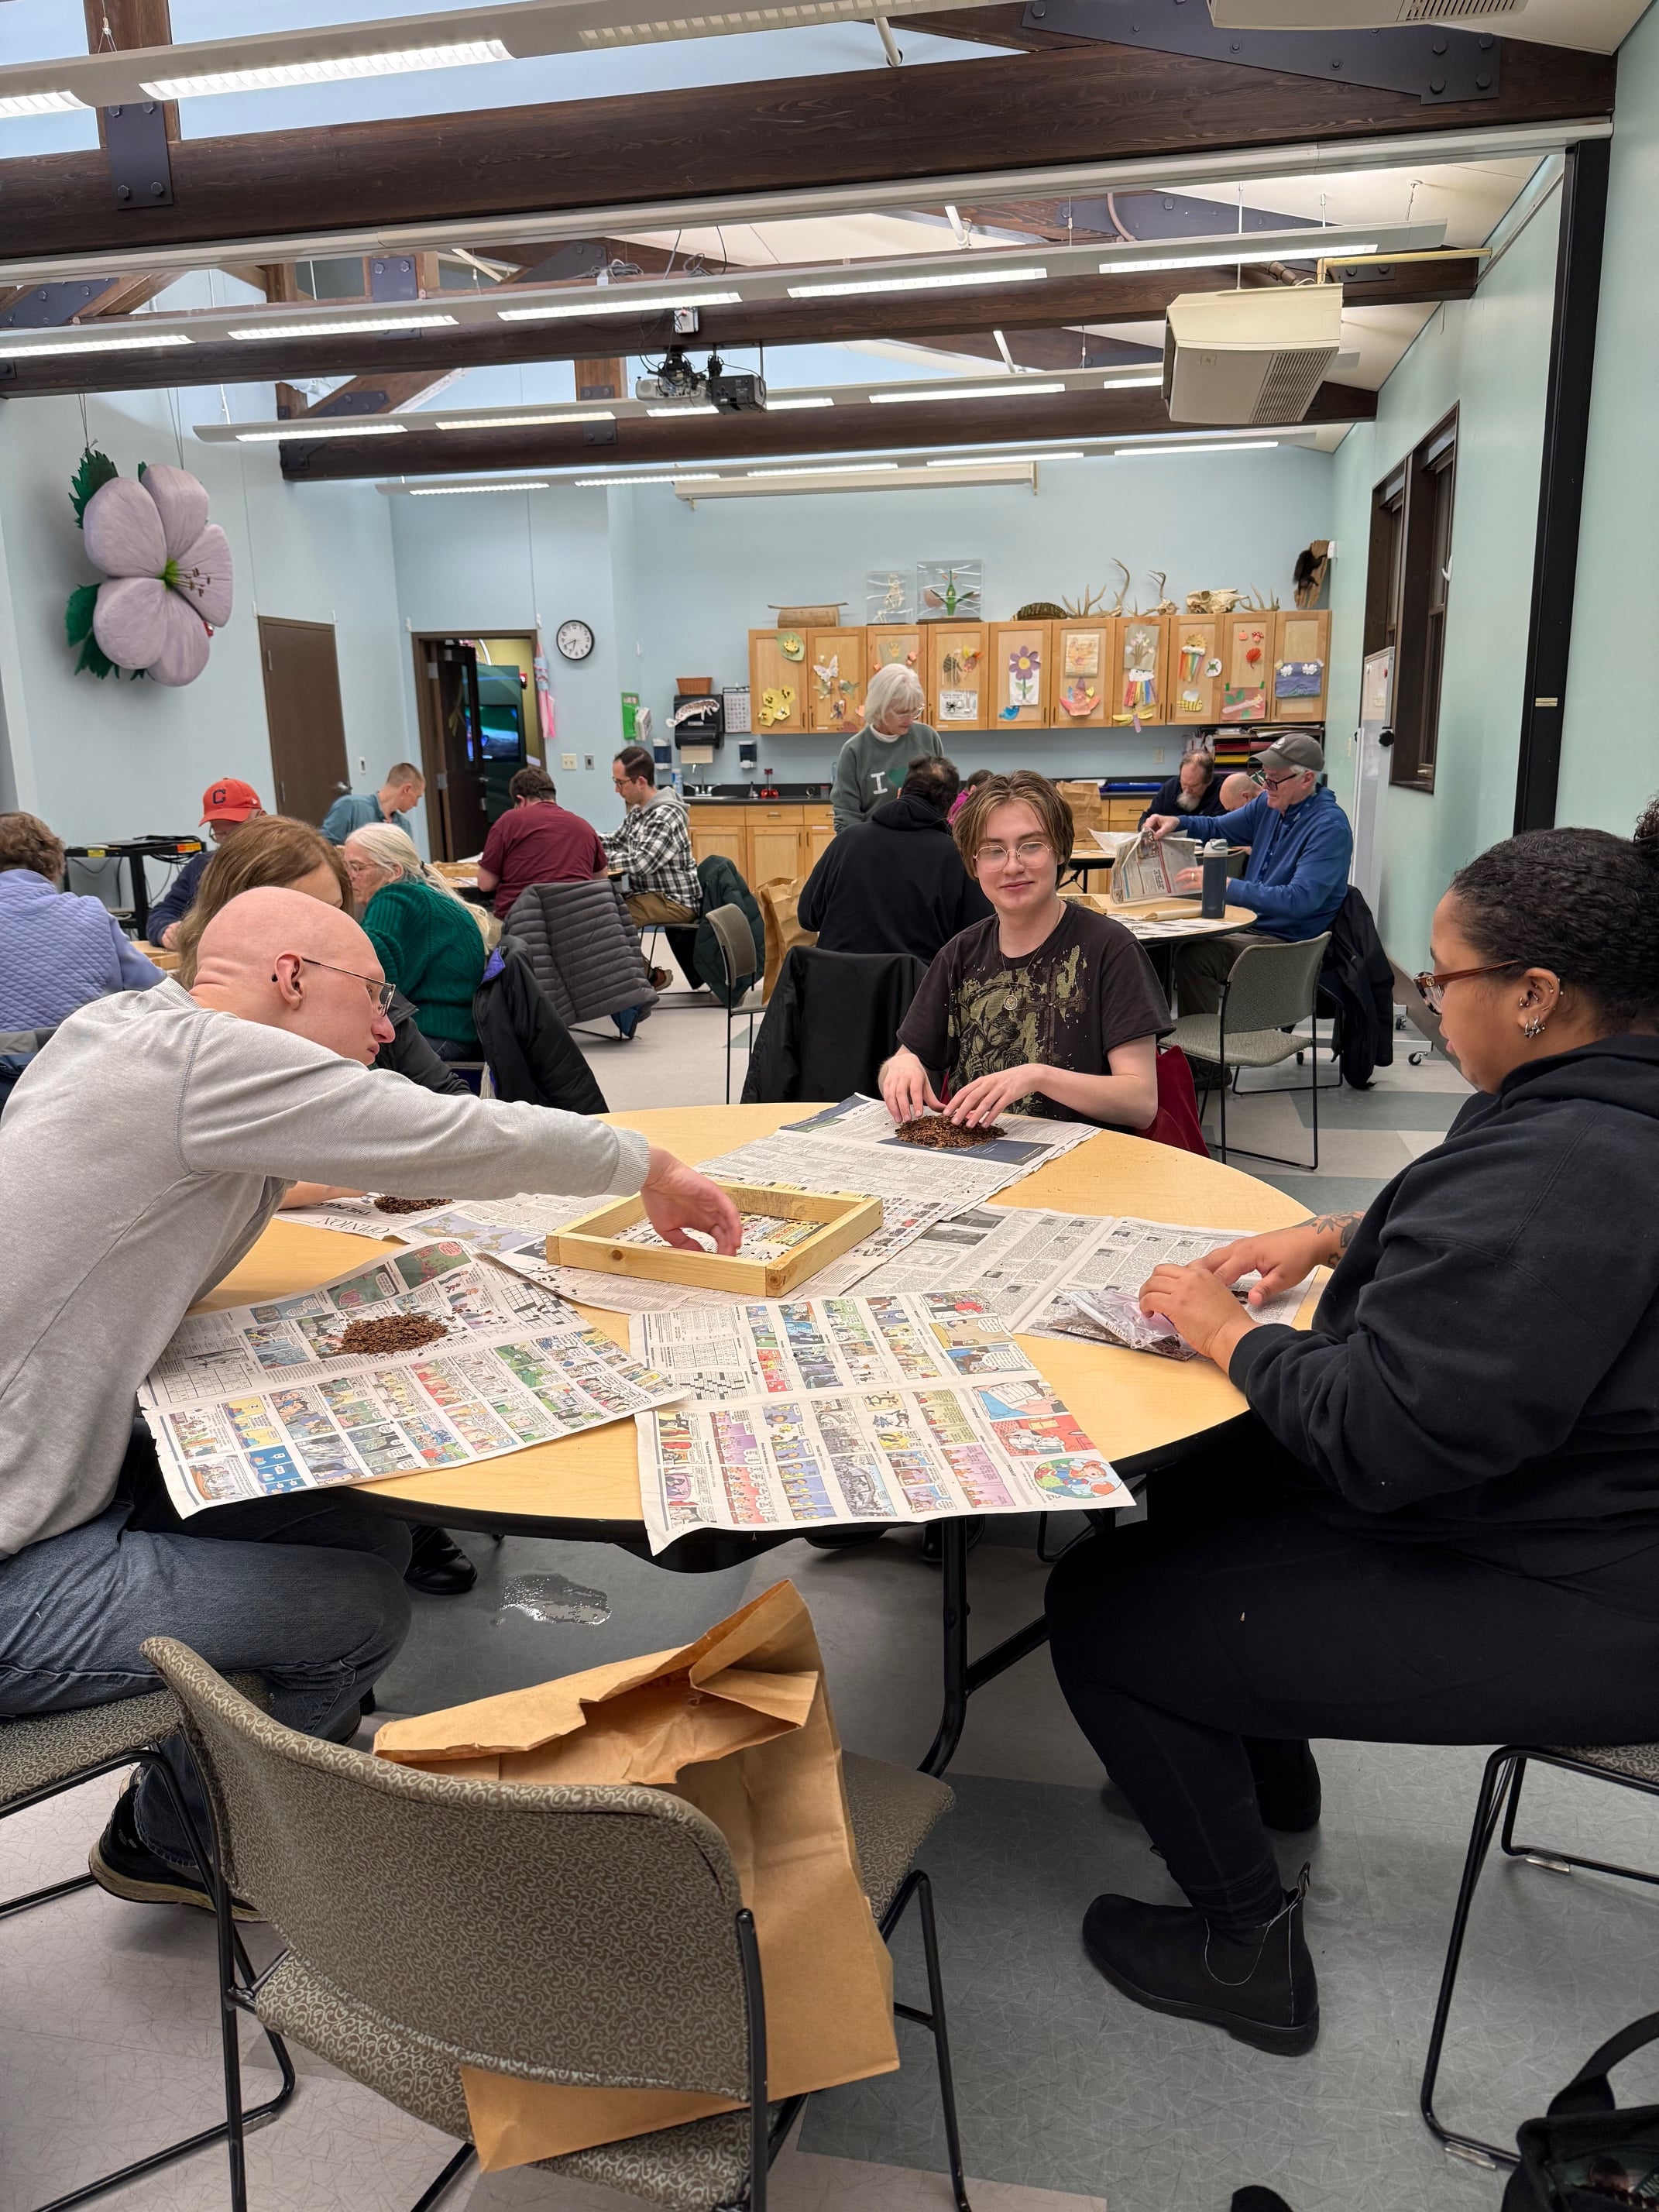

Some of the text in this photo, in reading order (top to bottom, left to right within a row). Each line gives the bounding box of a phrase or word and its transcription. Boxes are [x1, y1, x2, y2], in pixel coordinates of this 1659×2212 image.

[871, 771, 888, 795] I
[212, 788, 226, 804] C
[346, 1207, 371, 1216] THE
[315, 1217, 390, 1234] OPINION
